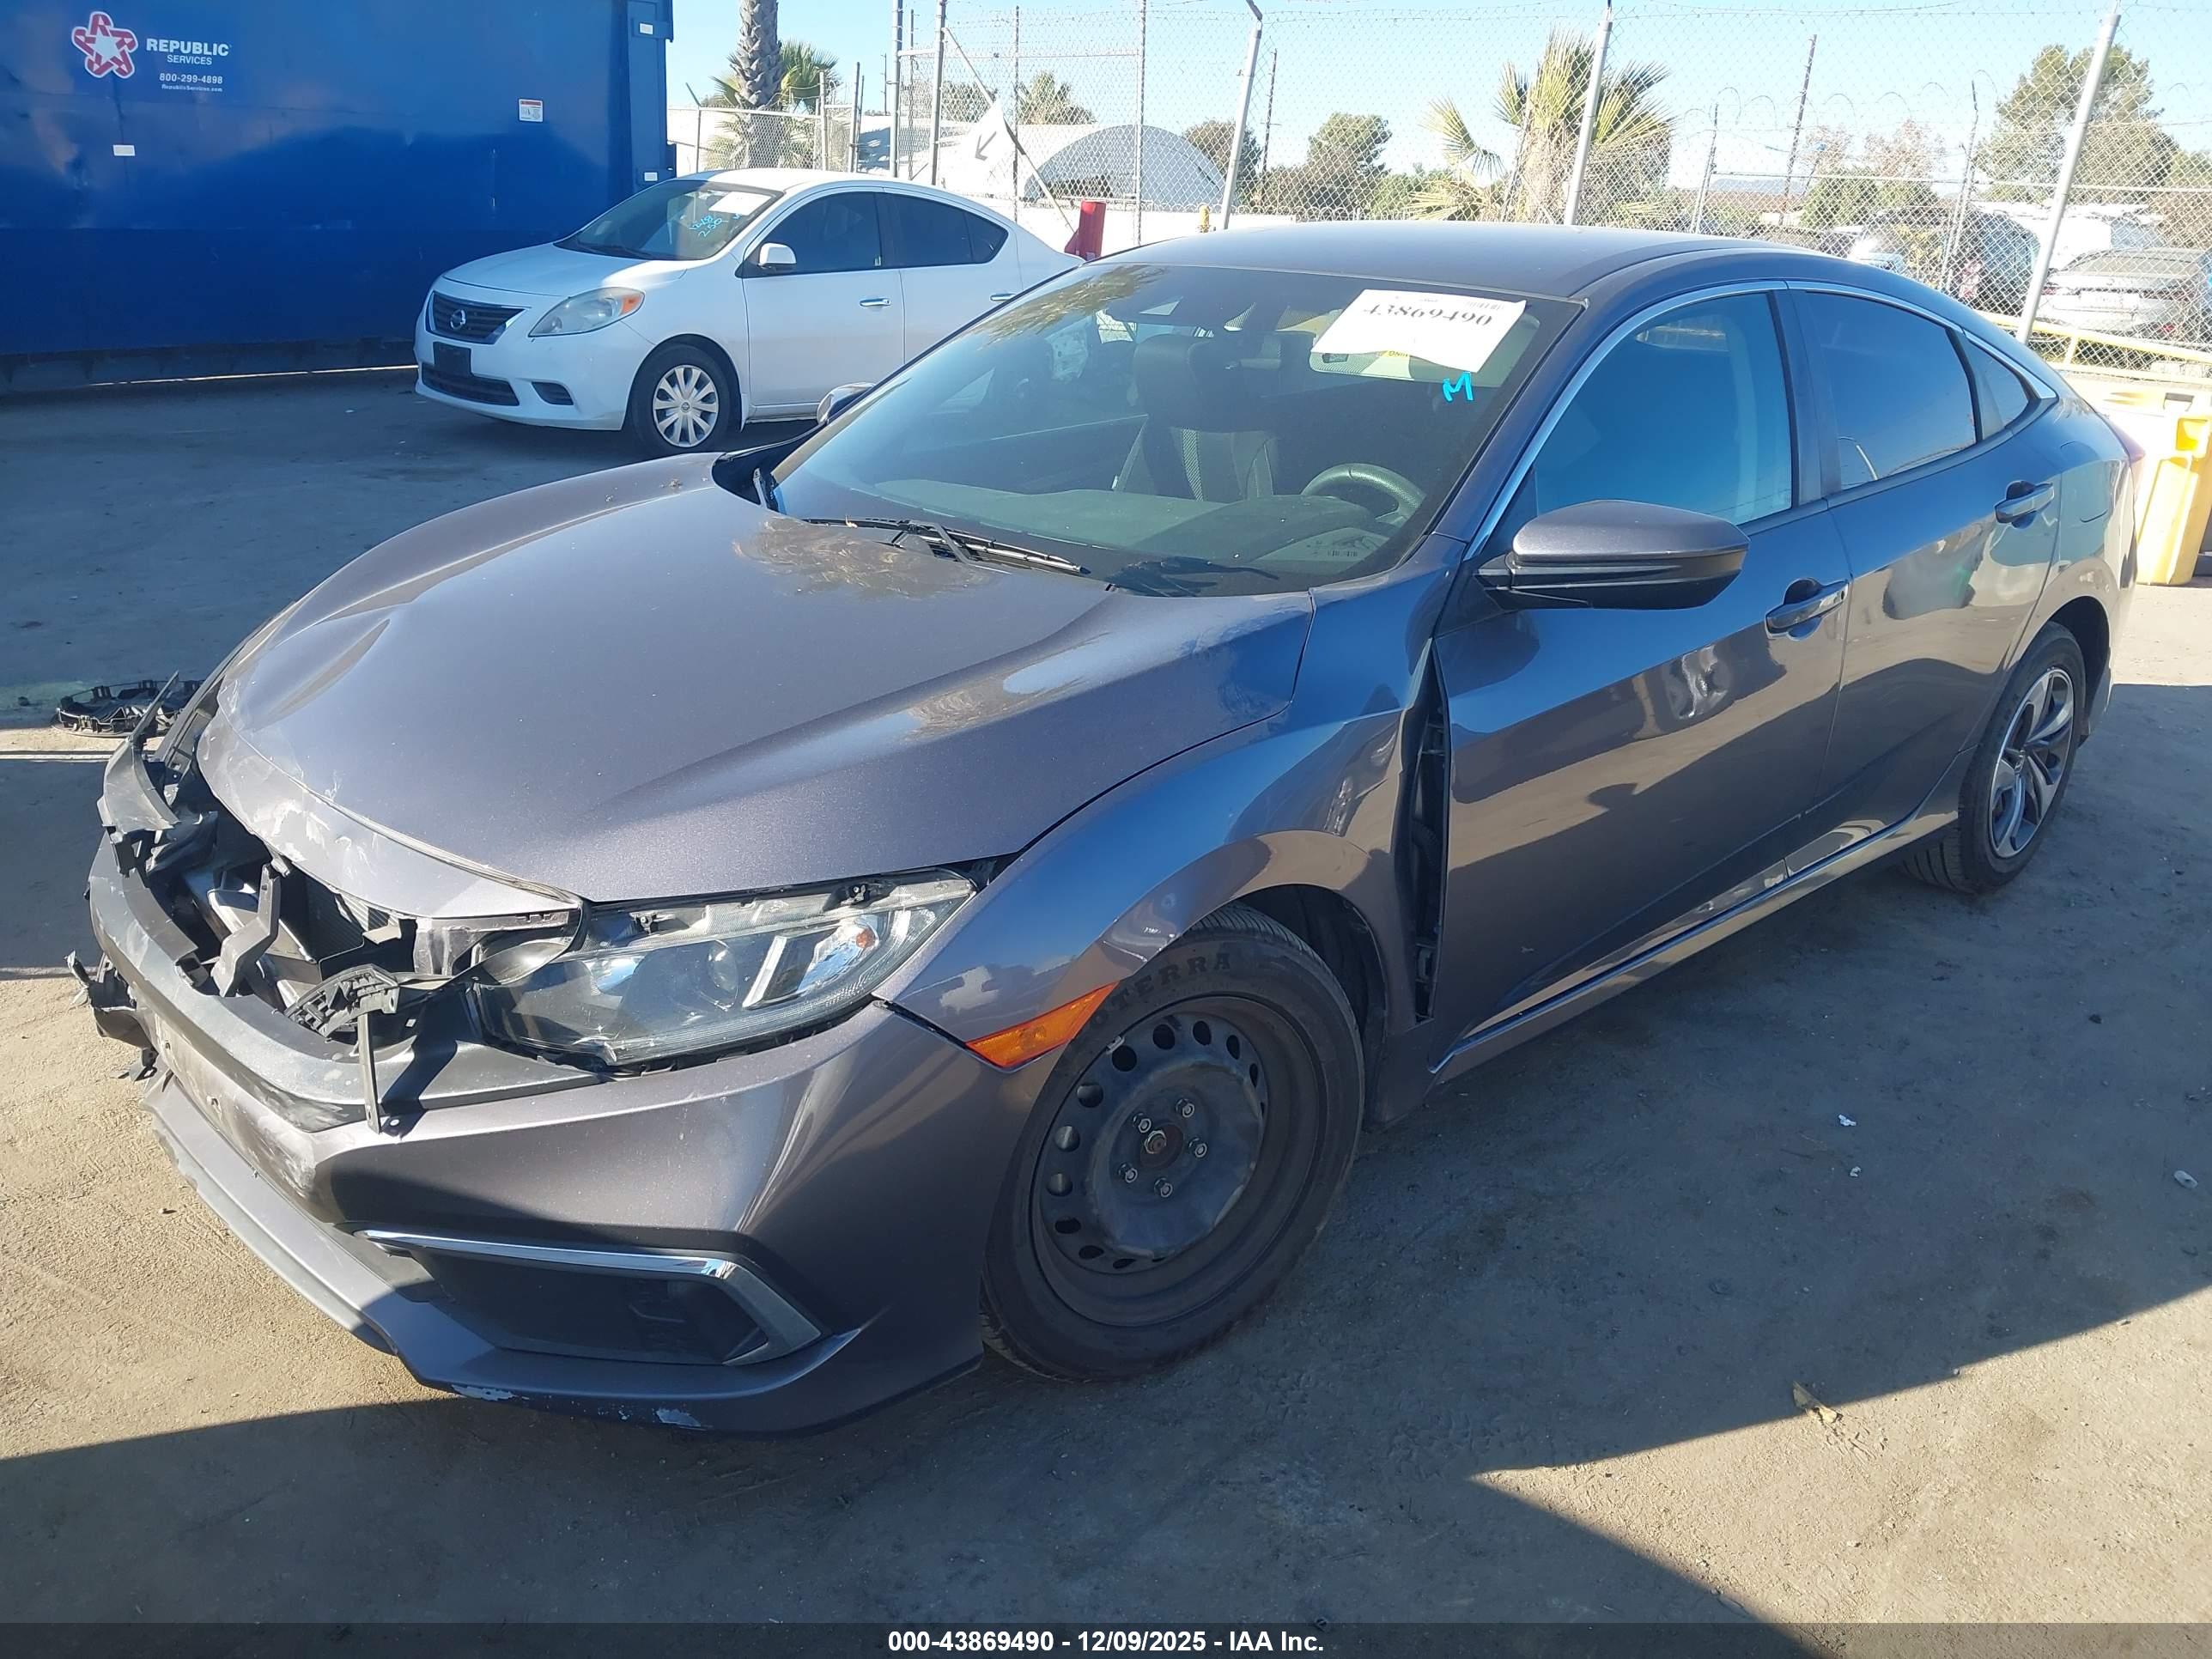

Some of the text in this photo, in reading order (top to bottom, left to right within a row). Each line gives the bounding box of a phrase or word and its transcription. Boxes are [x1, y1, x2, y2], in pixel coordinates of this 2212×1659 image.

[146, 38, 229, 57] REPUBLIC
[167, 54, 212, 65] SERVICES
[159, 72, 223, 84] 800-299-4898
[1443, 371, 1474, 402] M
